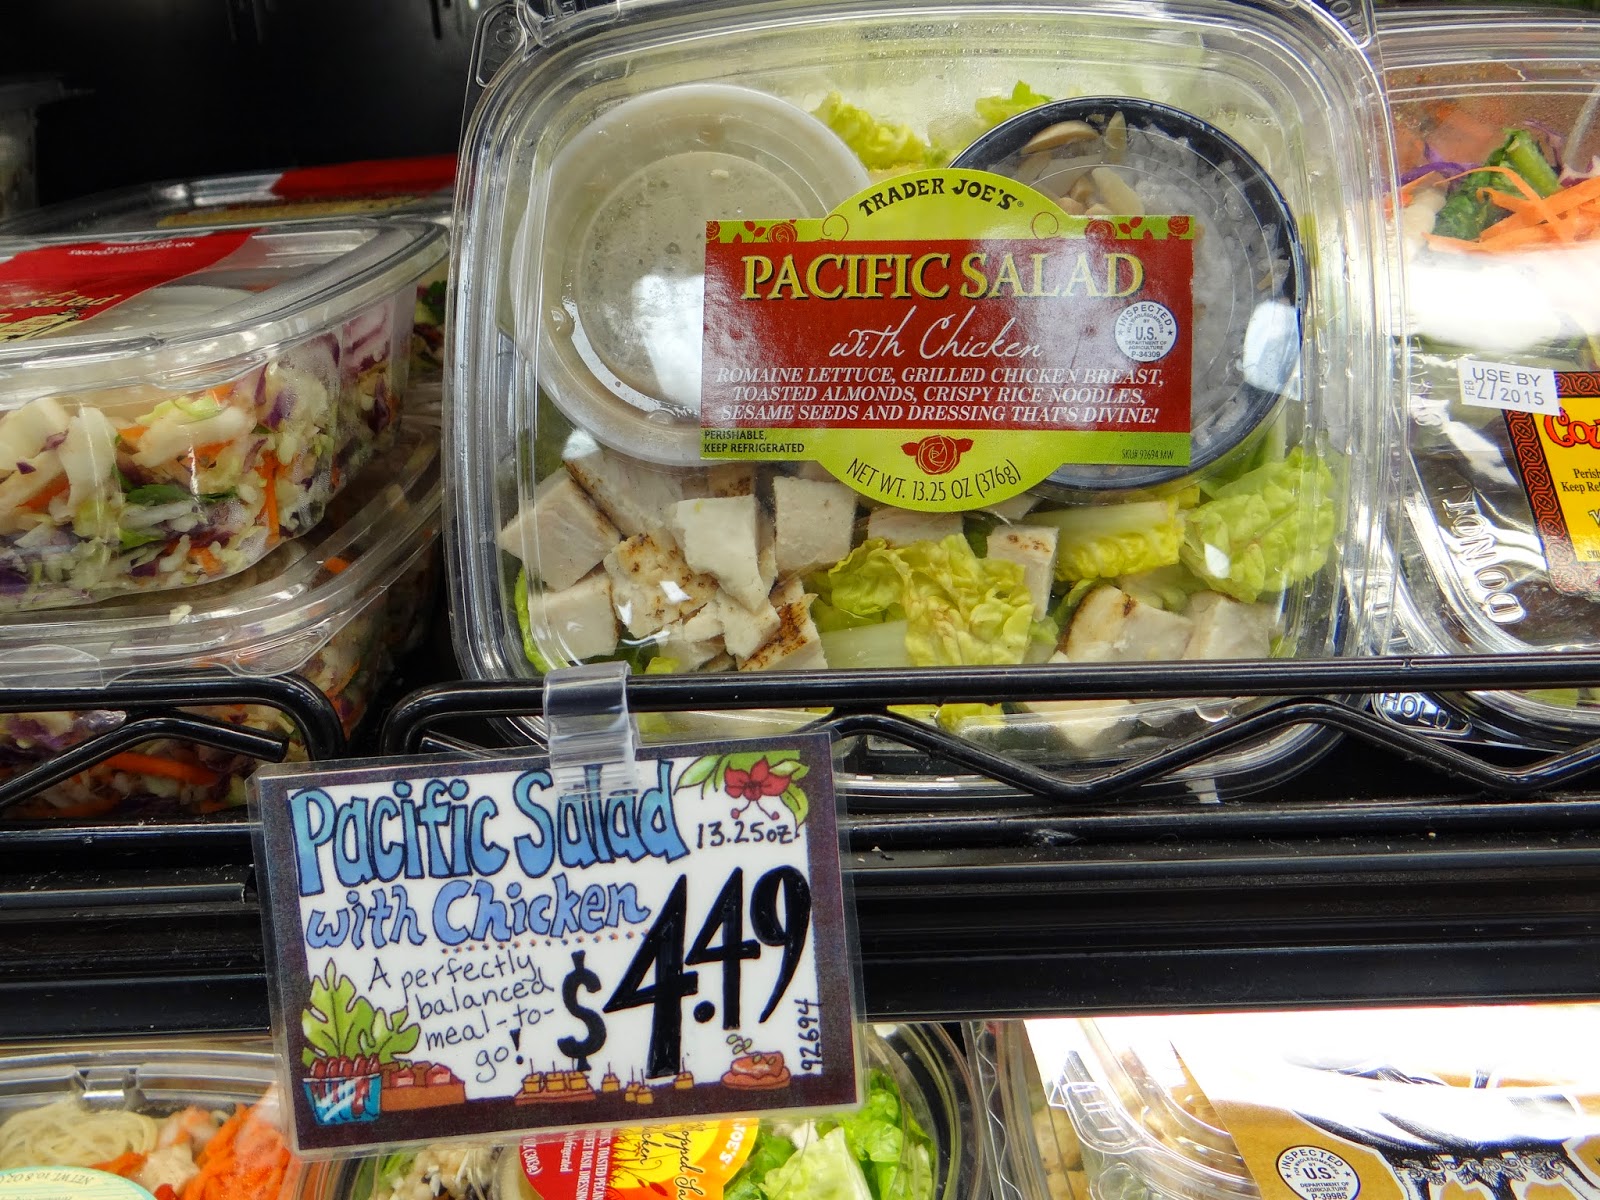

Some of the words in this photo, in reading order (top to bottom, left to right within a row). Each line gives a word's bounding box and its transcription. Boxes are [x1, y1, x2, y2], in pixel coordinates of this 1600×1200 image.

[858, 178, 945, 217] TRADER
[951, 178, 1018, 211] JOE'S
[741, 252, 951, 300] PACIFIC
[960, 252, 1147, 300] SALAD
[1118, 304, 1173, 327] INSPECTED
[828, 305, 917, 359] with
[919, 305, 1045, 360] Chicken
[1135, 326, 1157, 340] U.S.
[1131, 350, 1161, 358] P-34309
[716, 367, 803, 383] ROMAINE
[806, 367, 896, 385] LETTUCE,
[901, 367, 986, 383] GRILLED
[990, 367, 1080, 384] CHICKEN
[1081, 368, 1164, 387] BREAST,
[1472, 366, 1512, 384] USE
[1516, 372, 1541, 387] BY
[733, 386, 818, 401] TOASTED
[820, 386, 918, 403] ALMONDS,
[923, 386, 995, 402] CRISPY
[997, 386, 1044, 402] RICE
[1048, 387, 1146, 406] NOODLES,
[1463, 380, 1476, 396] FEB
[1500, 387, 1545, 406] 2015
[721, 405, 795, 421] SESAME
[798, 405, 859, 421] SEEDS
[862, 405, 904, 421] AND
[907, 405, 1006, 422] DRESSING
[1011, 405, 1080, 422] THAT'S
[1084, 407, 1160, 424] DIVINE!
[703, 430, 767, 441] PERISHABLE,
[703, 443, 728, 453] KEEP
[730, 443, 805, 453] REFRIGERATED
[846, 457, 880, 487] NET
[880, 473, 906, 499] WT.
[912, 480, 946, 501] 13.25
[951, 477, 973, 499] OZ
[975, 458, 1022, 499] (376g)
[1560, 481, 1586, 494] Keep
[288, 778, 510, 897] Pacific
[513, 758, 691, 879] Salad
[696, 821, 795, 849] 13.25oz
[305, 884, 428, 950] with
[432, 872, 652, 946] Chicken
[368, 957, 391, 992] A
[401, 949, 538, 1004] perfectly
[556, 864, 812, 1080] $4.49
[415, 967, 555, 1020] balanced
[425, 1004, 555, 1051] meal-to-
[794, 998, 823, 1072] 92694
[475, 1028, 524, 1083] go!
[522, 1149, 543, 1175] (303g)
[580, 1150, 594, 1171] BASIL
[595, 1146, 610, 1177] TOASTED
[1281, 1149, 1344, 1170] INSPECTED
[1302, 1166, 1336, 1180] U.S.
[1311, 1192, 1348, 1200] P-39985
